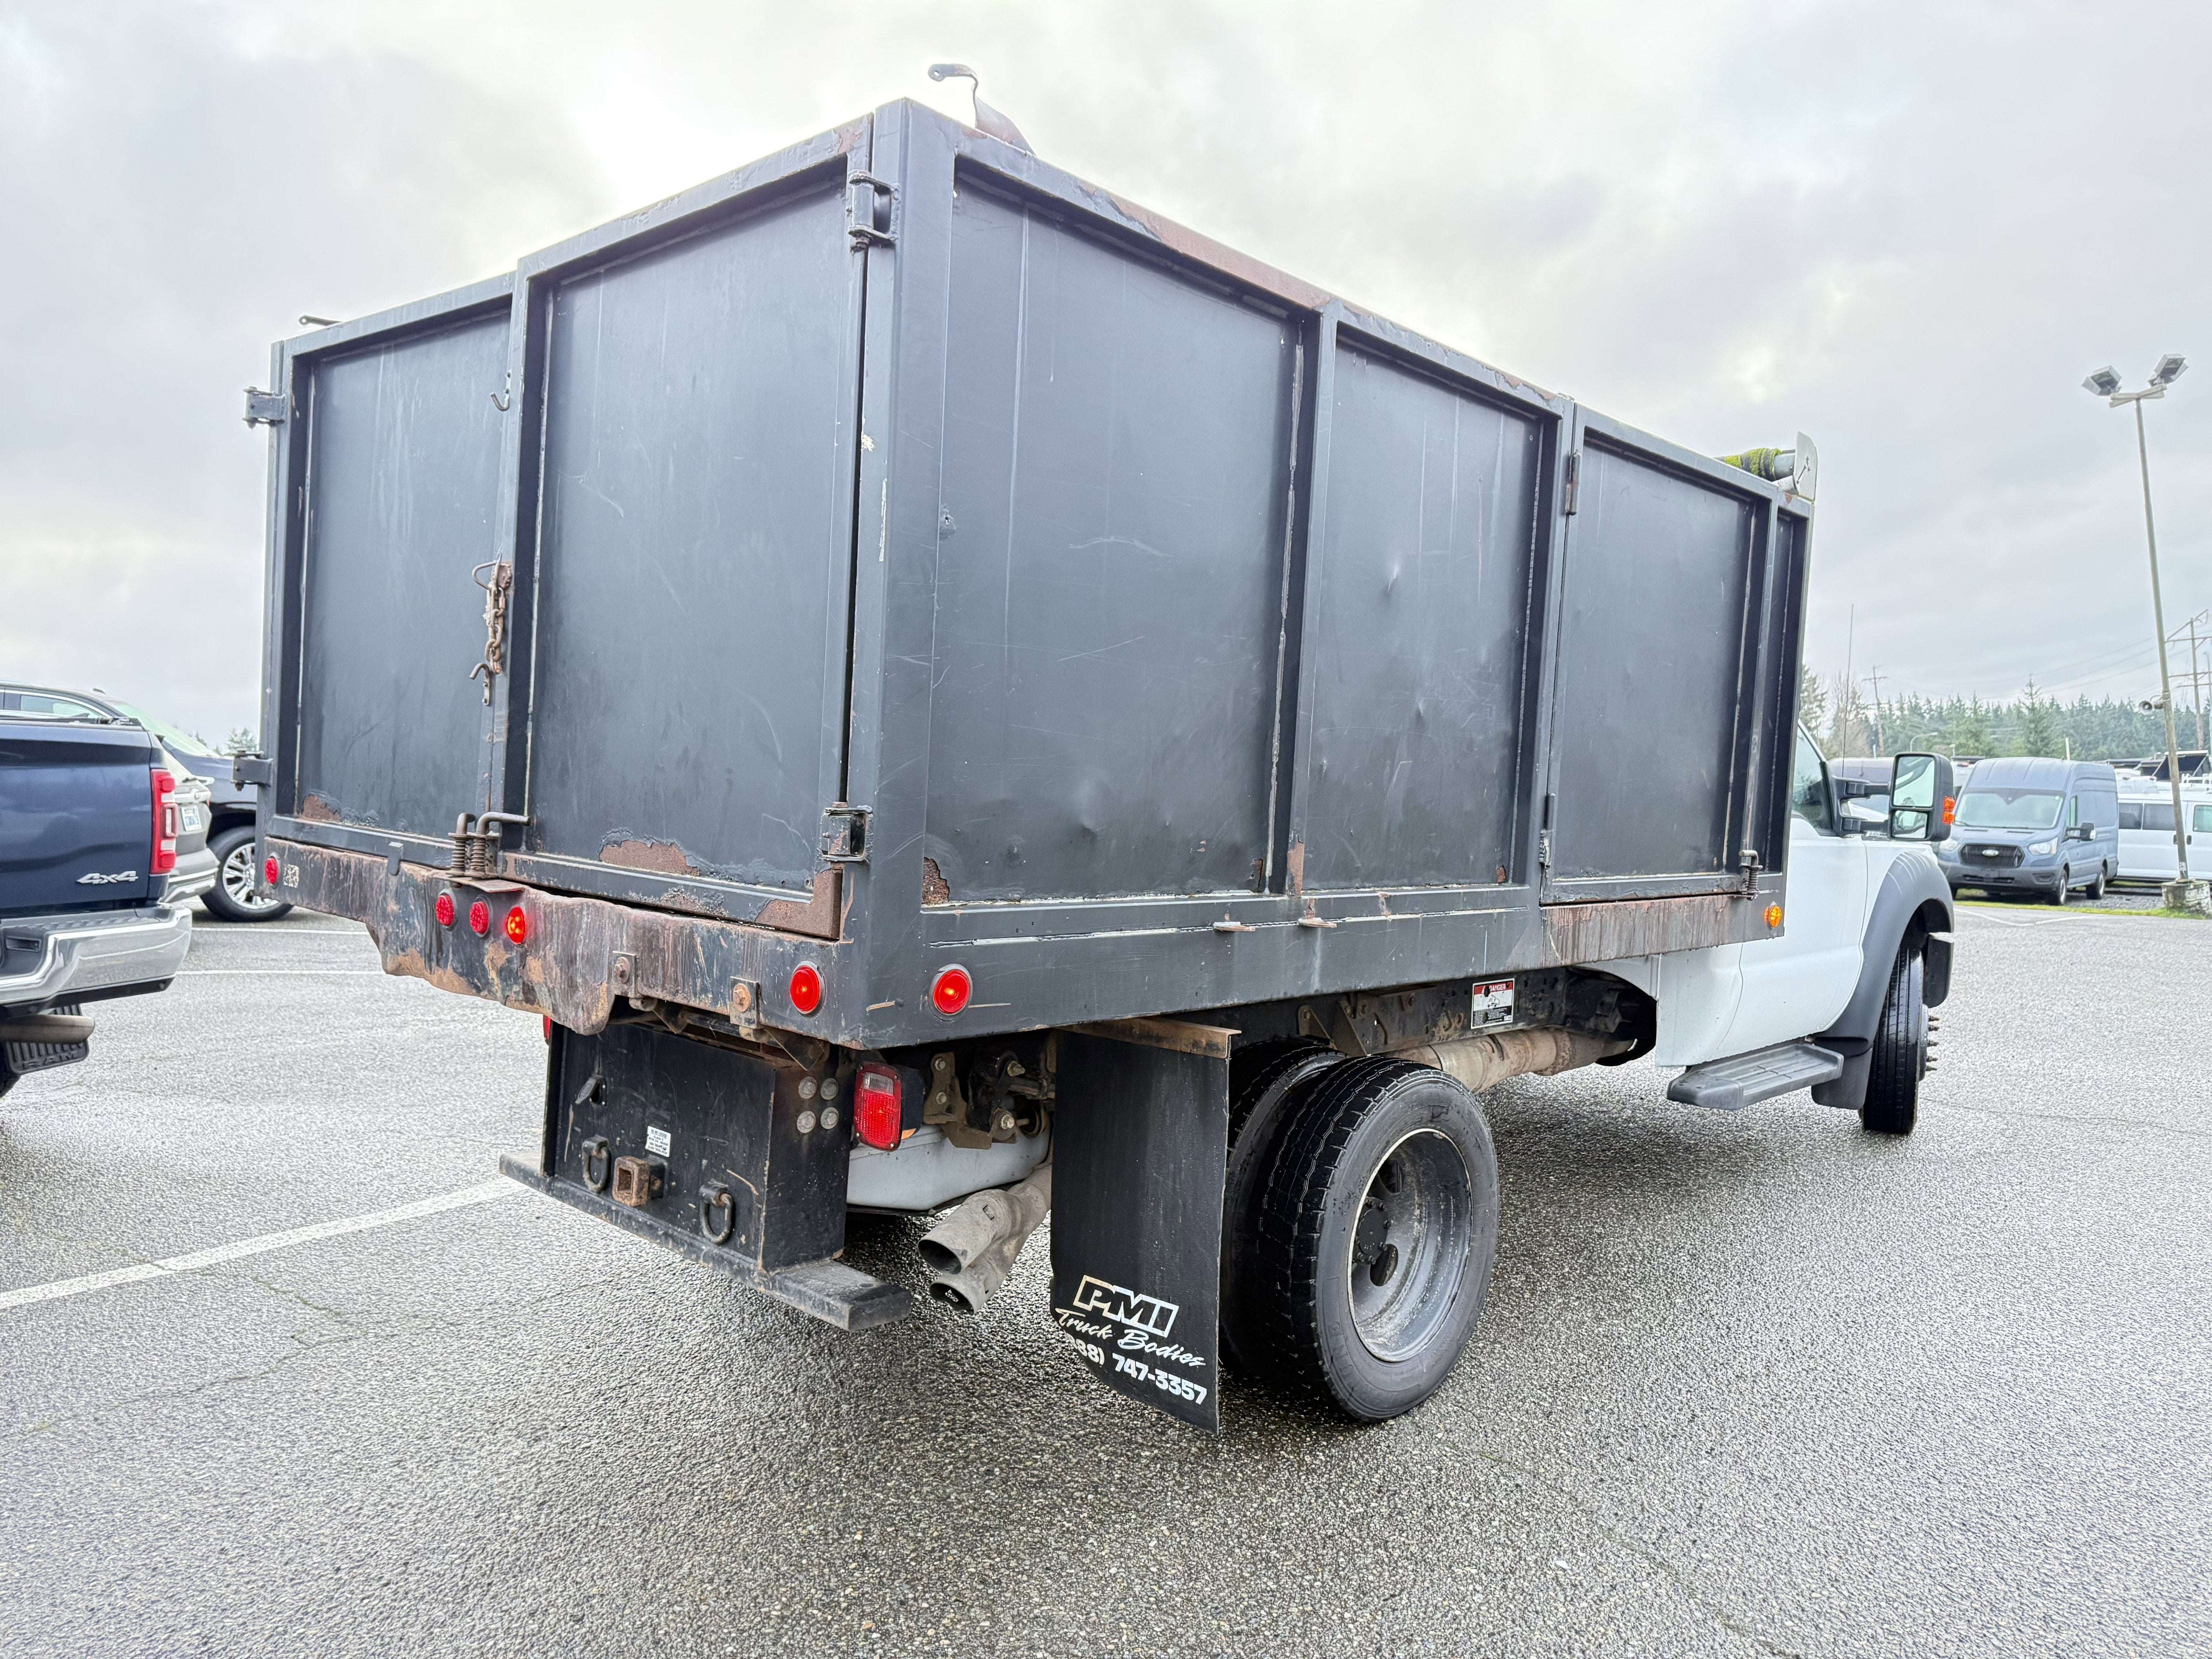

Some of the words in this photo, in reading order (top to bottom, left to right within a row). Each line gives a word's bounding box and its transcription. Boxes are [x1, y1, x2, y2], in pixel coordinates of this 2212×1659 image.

[77, 871, 138, 884] 4x4
[1489, 983, 1506, 992] DANGER
[1073, 1274, 1179, 1338] PMI
[1055, 1308, 1113, 1340] Truck
[1117, 1329, 1206, 1367] Bodies
[1112, 1353, 1207, 1405] 747-3357
